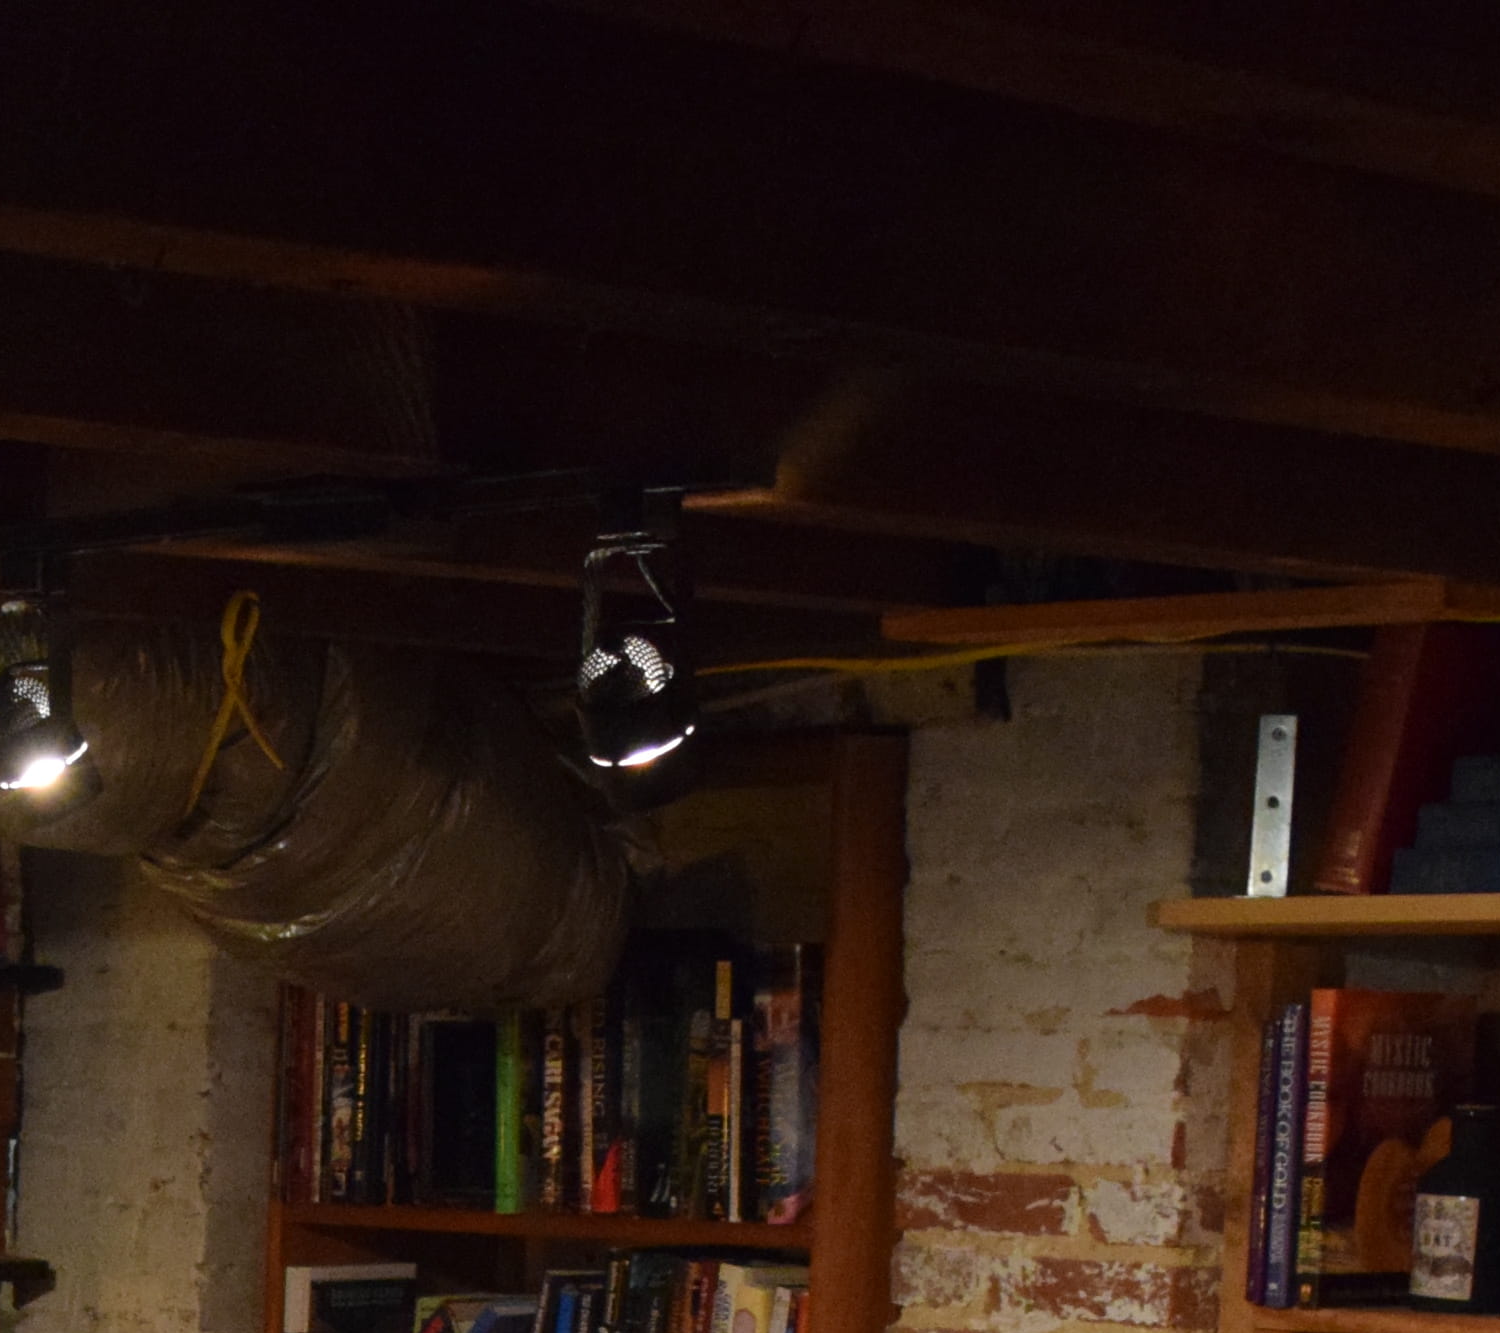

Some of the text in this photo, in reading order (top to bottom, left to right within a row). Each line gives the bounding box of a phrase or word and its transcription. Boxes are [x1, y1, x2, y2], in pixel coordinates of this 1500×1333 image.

[1303, 1015, 1332, 1163] MYSTIC COOKBOOK
[1362, 1070, 1436, 1101] COOKBOOK
[1369, 1033, 1434, 1068] MYSTIC
[1270, 1014, 1298, 1210] THE BOOK OF GOLD
